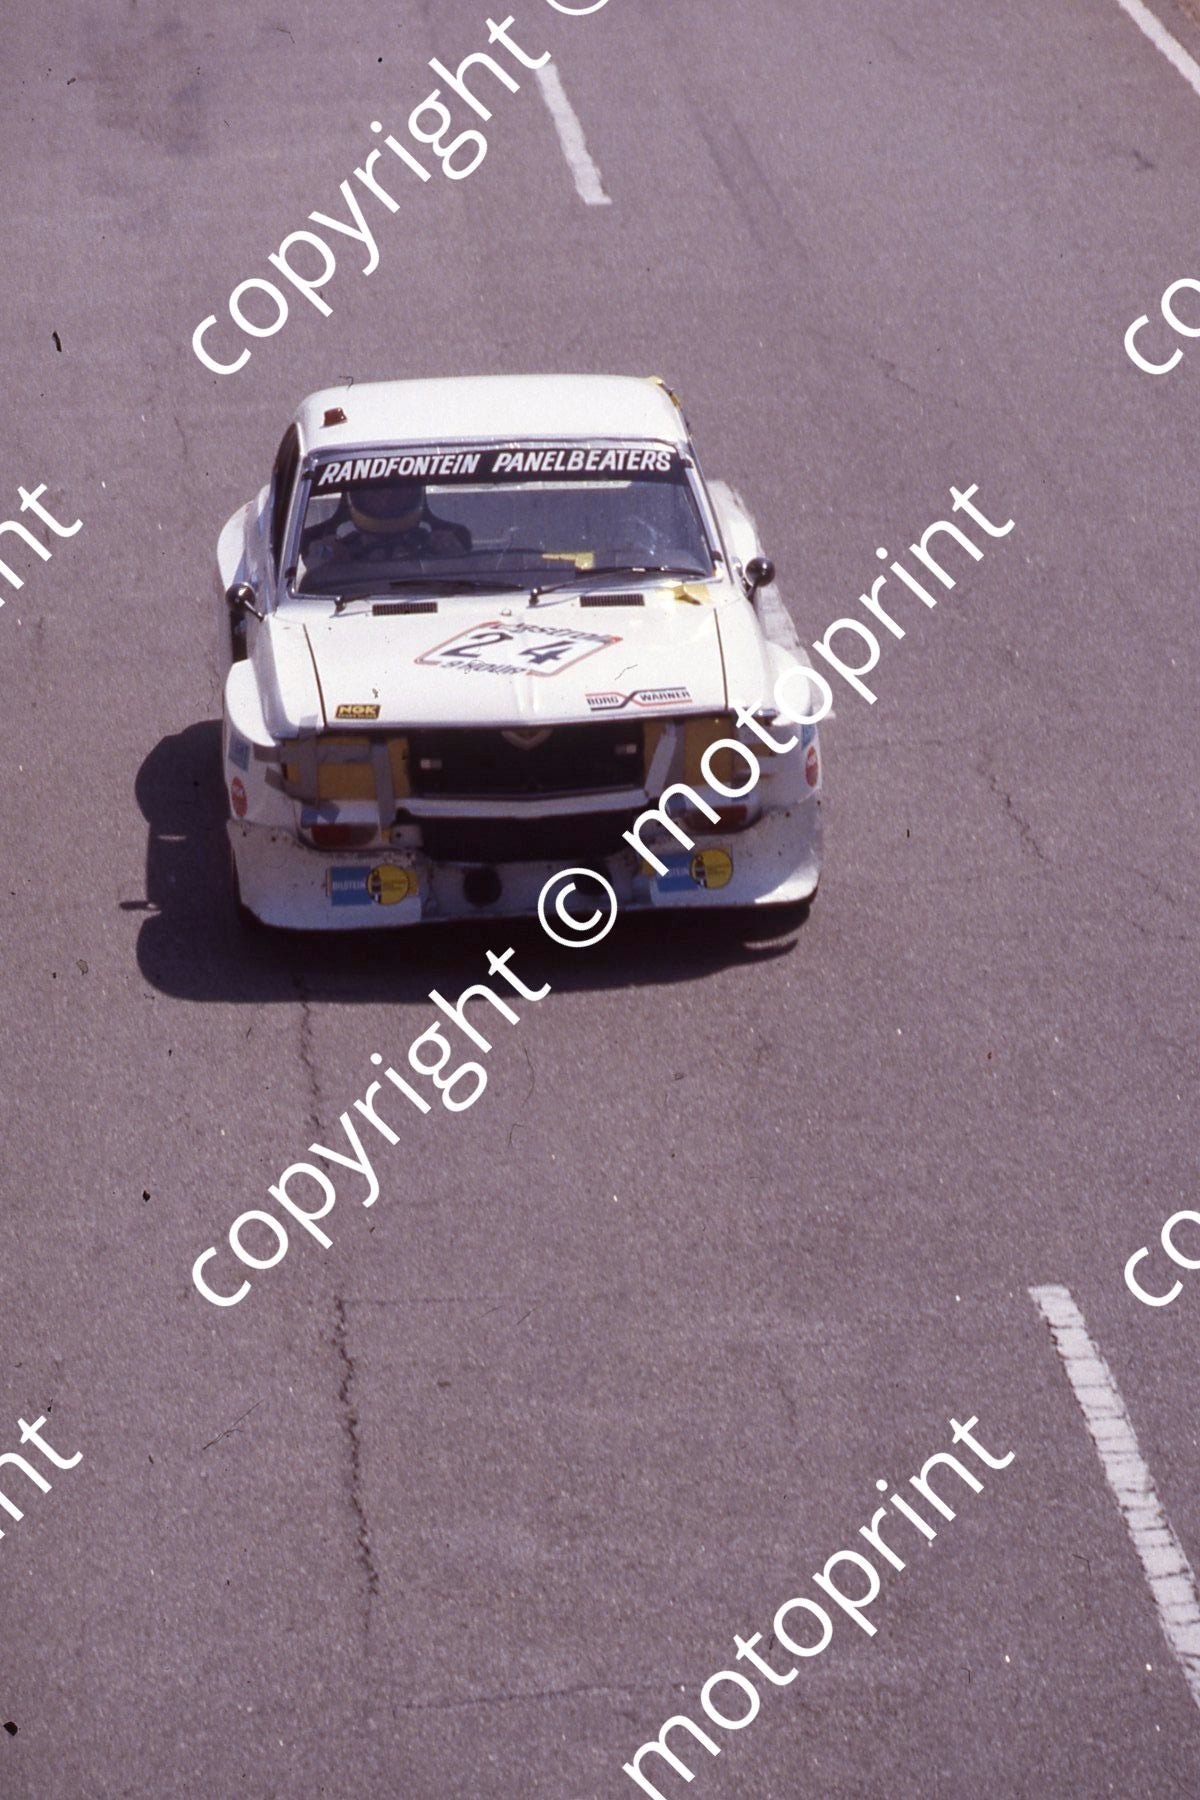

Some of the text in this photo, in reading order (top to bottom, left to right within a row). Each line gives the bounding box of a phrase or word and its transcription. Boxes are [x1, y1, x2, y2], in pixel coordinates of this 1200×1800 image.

[317, 449, 671, 486] RANDFONTEIN PANELBEATERS
[640, 690, 692, 702] WARNER
